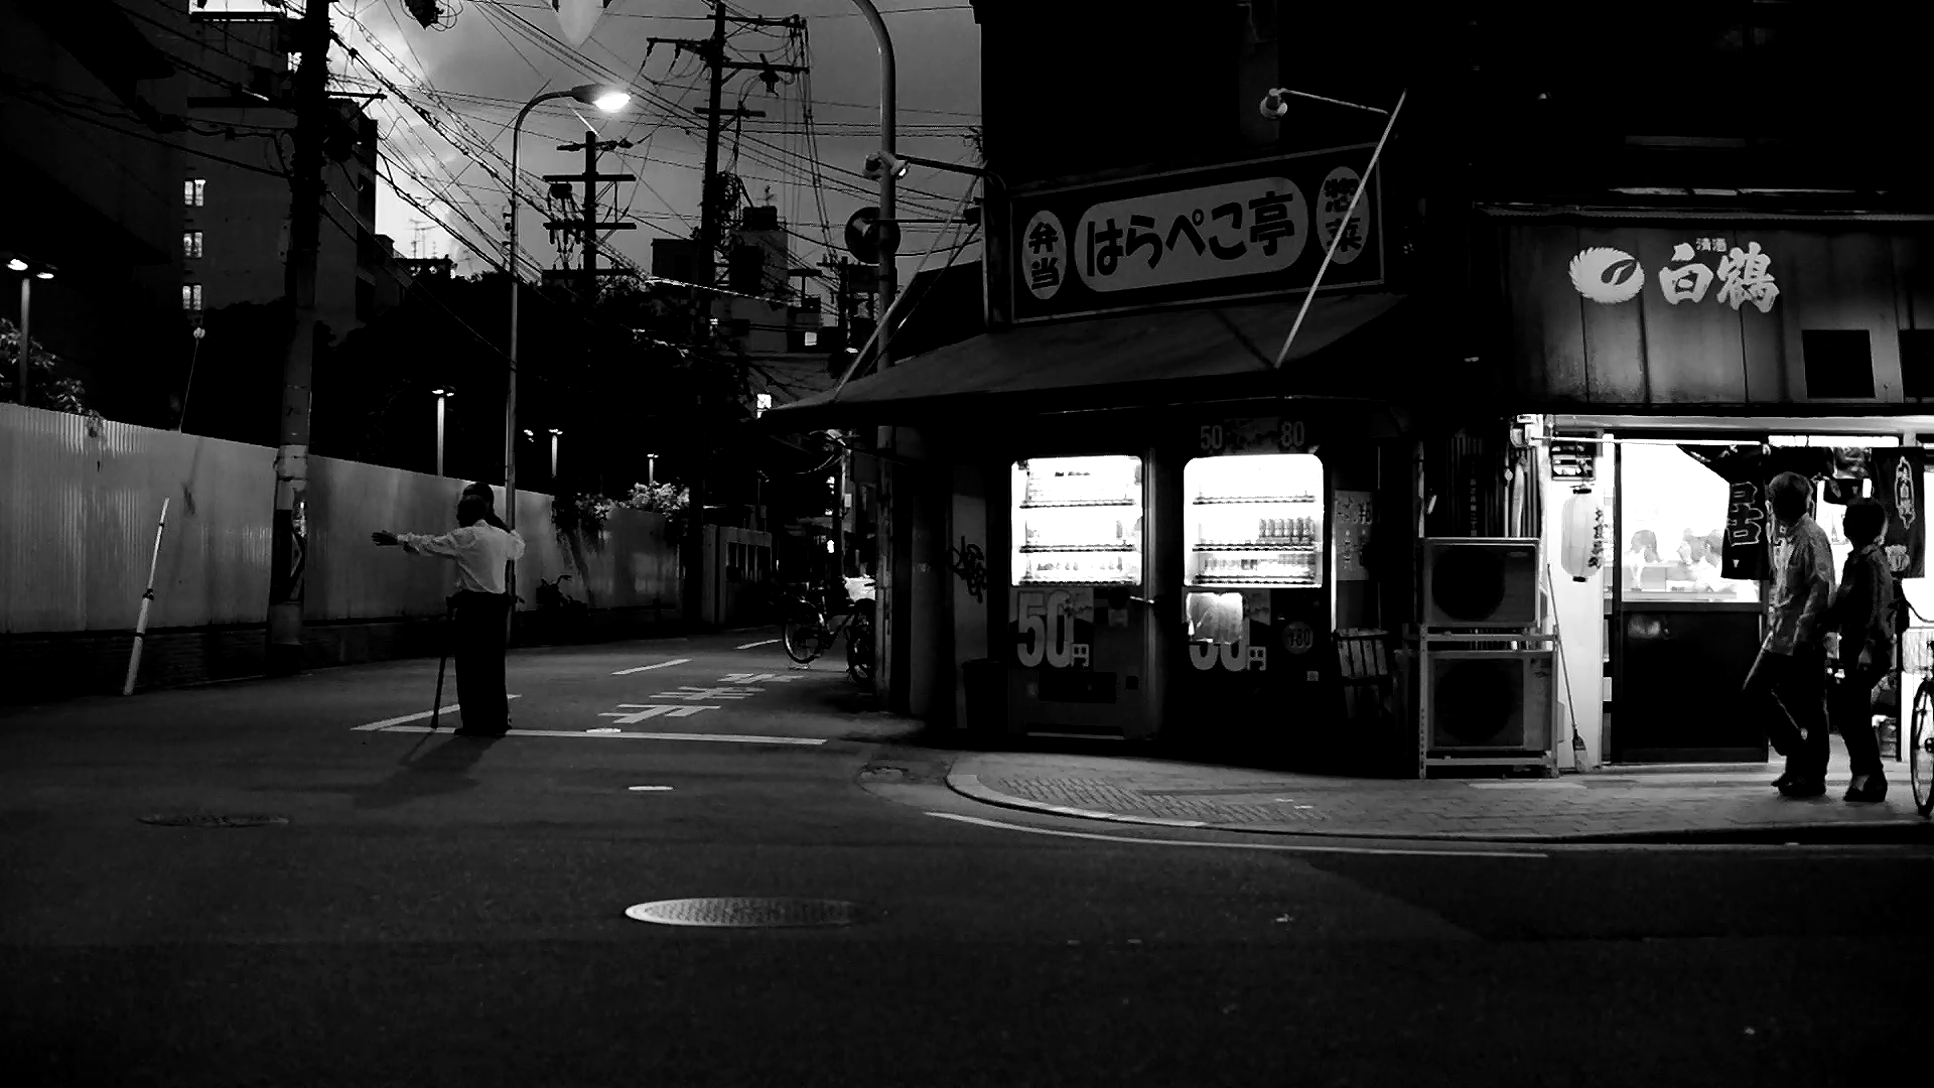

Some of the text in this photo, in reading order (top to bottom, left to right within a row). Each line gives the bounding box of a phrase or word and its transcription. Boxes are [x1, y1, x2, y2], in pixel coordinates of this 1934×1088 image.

[1028, 221, 1060, 291] 弁当
[1086, 191, 1295, 277] はらぺこ亭
[1658, 241, 1781, 314] 白鶴
[1199, 423, 1224, 451] 50
[1280, 420, 1306, 449] 80
[1016, 590, 1090, 669] 50円
